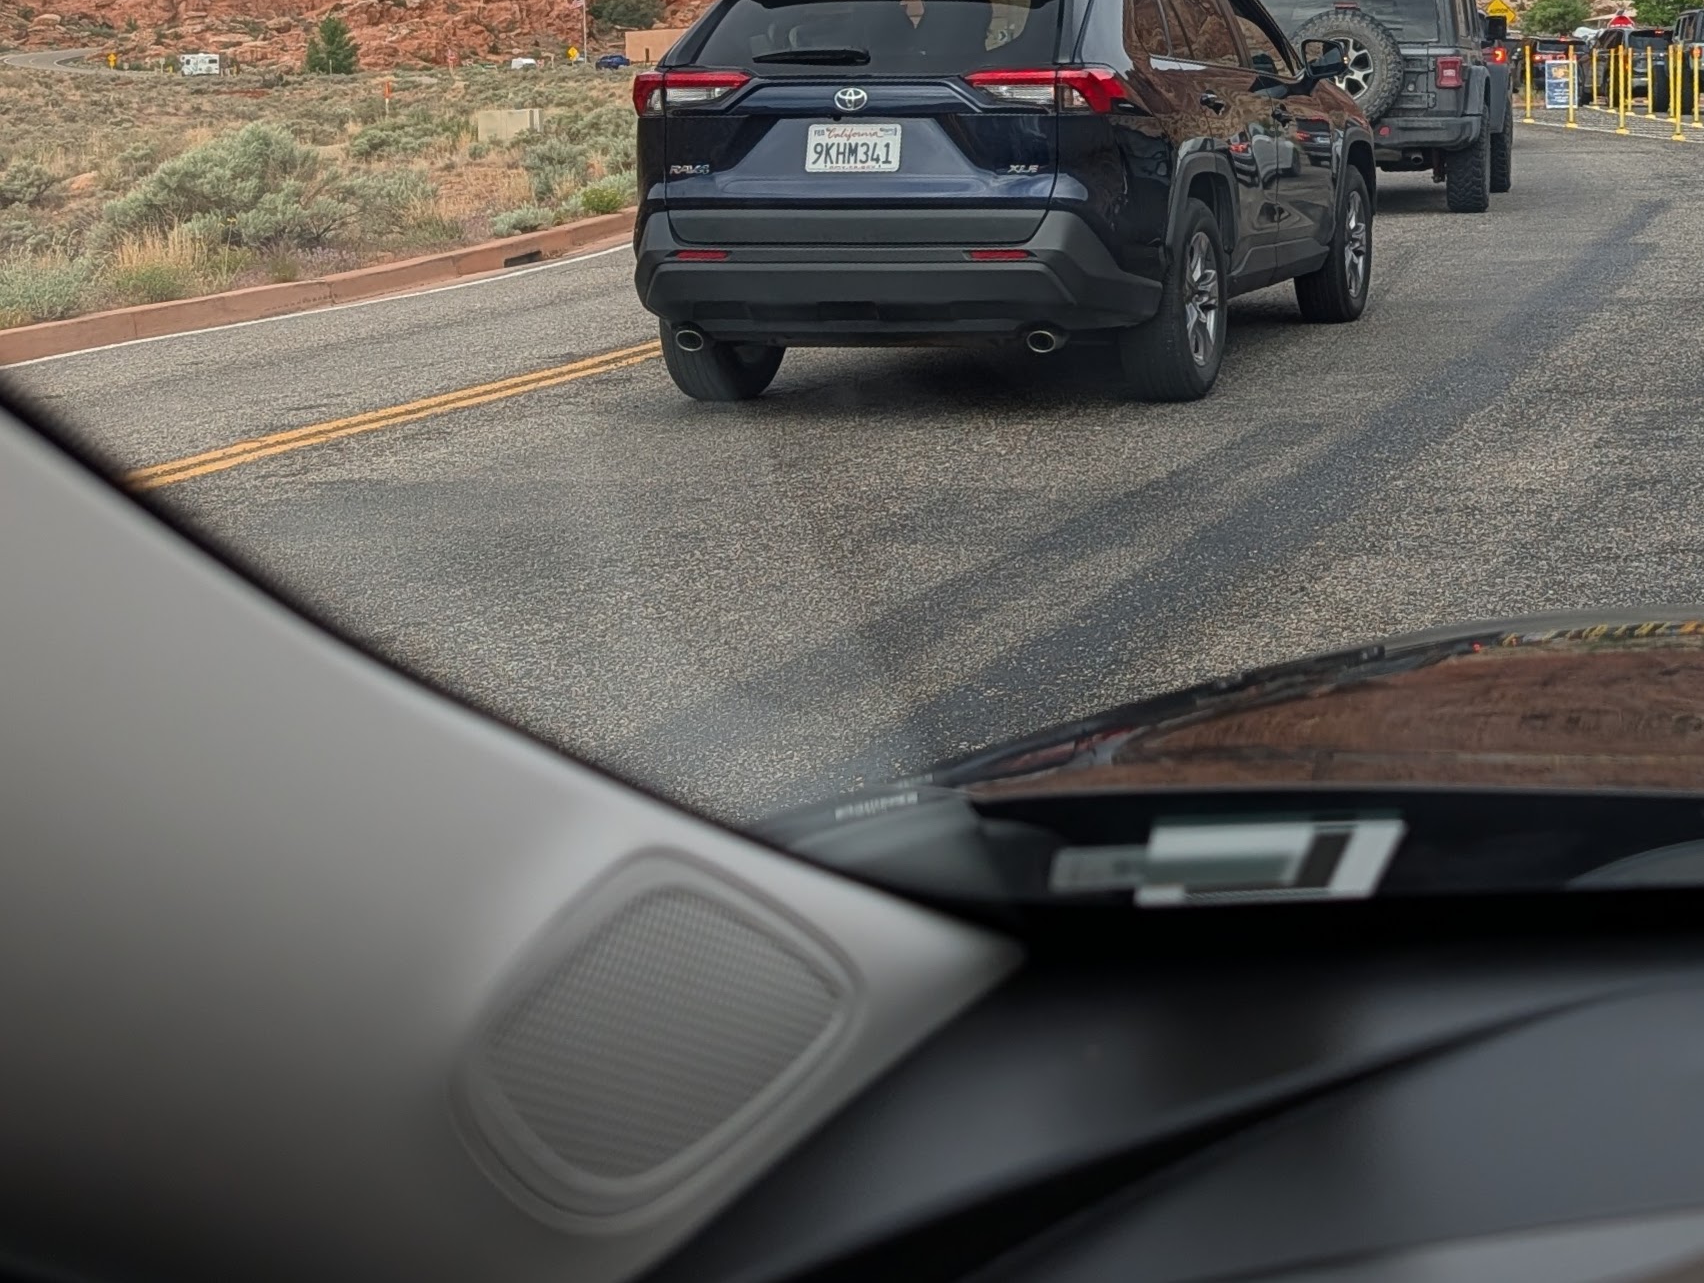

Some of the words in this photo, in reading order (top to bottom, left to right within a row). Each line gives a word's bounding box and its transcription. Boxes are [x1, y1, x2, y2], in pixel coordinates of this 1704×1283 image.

[826, 127, 883, 141] California
[812, 142, 892, 165] 9KHM341
[1007, 164, 1039, 173] XLE
